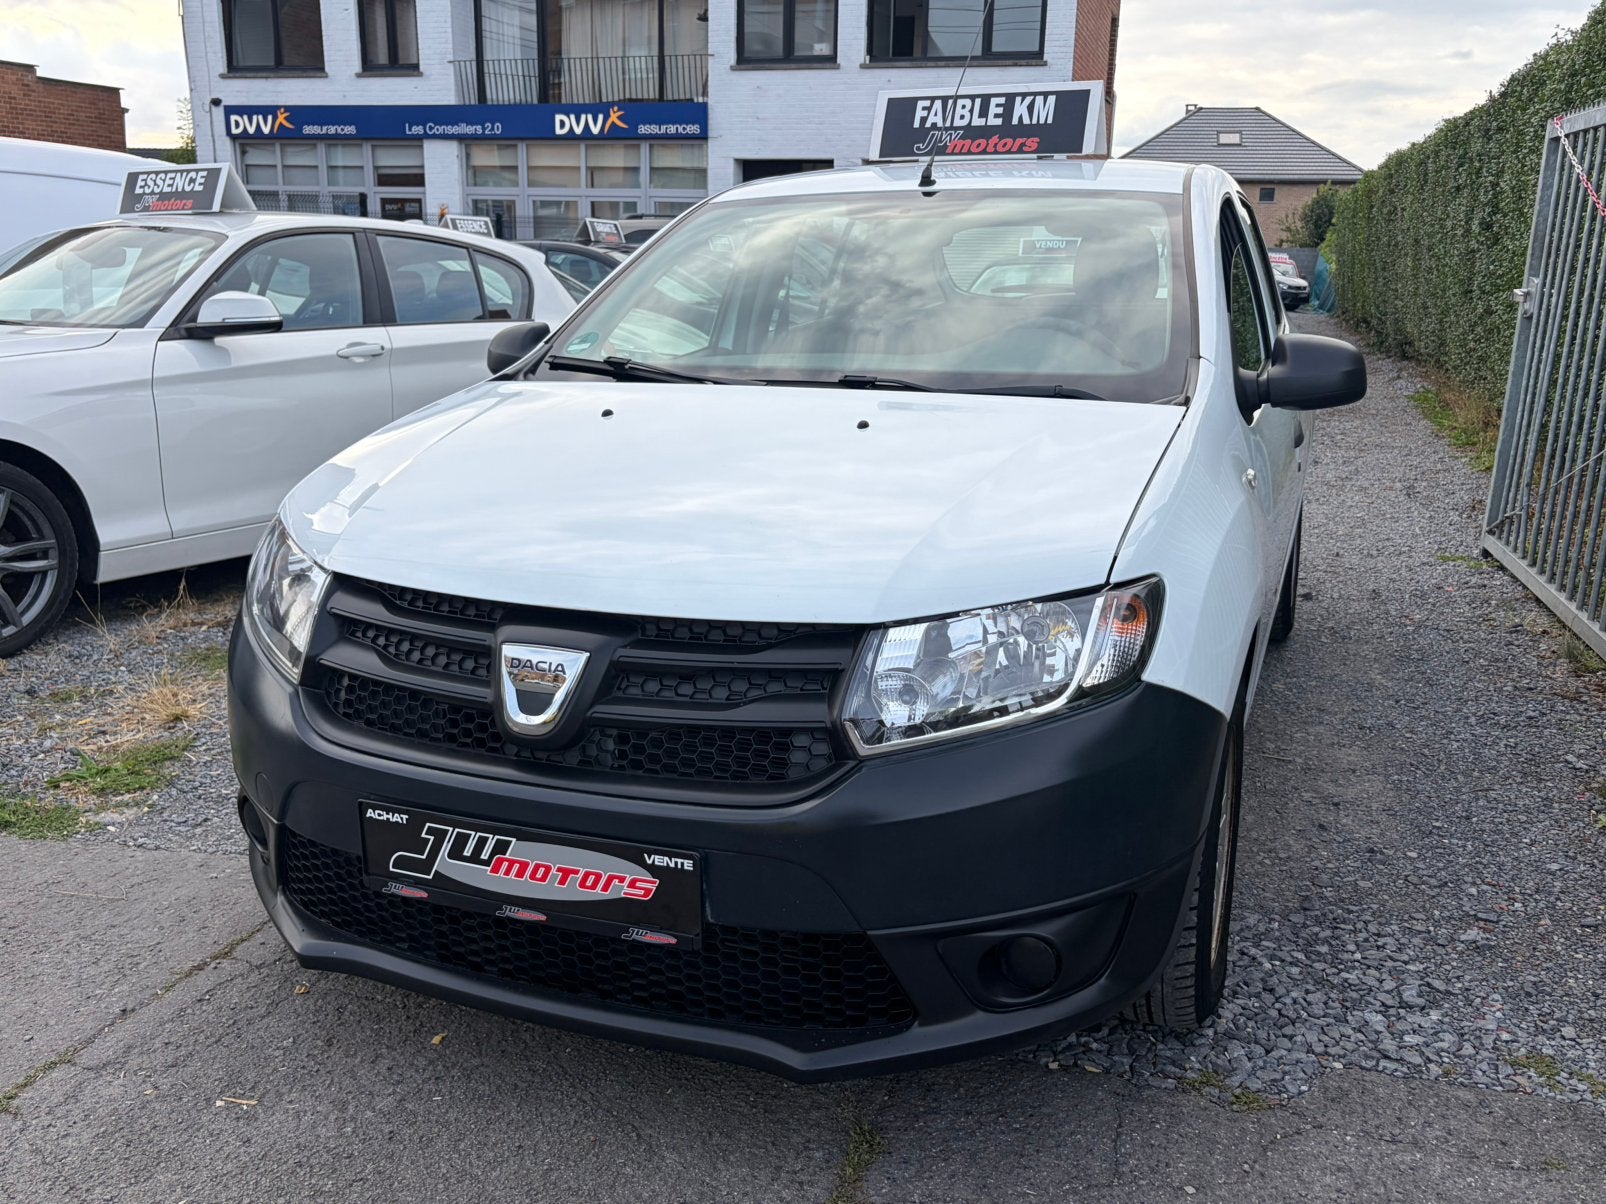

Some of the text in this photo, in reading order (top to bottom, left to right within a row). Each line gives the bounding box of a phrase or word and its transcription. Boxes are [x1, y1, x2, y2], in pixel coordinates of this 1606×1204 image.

[913, 94, 1056, 128] FAIBLE KM
[230, 114, 356, 135] DVV assurances
[405, 122, 502, 135] Les Conseillers 2.0
[555, 114, 700, 134] DVV assurances
[913, 130, 1040, 154] JW motors
[134, 171, 208, 194] ESSENCE
[149, 197, 193, 211] motors
[1035, 240, 1066, 248] VENDU
[509, 657, 567, 675] DACIA
[366, 808, 408, 824] ACHAT
[389, 822, 517, 879] JW
[643, 853, 693, 870] VENTE
